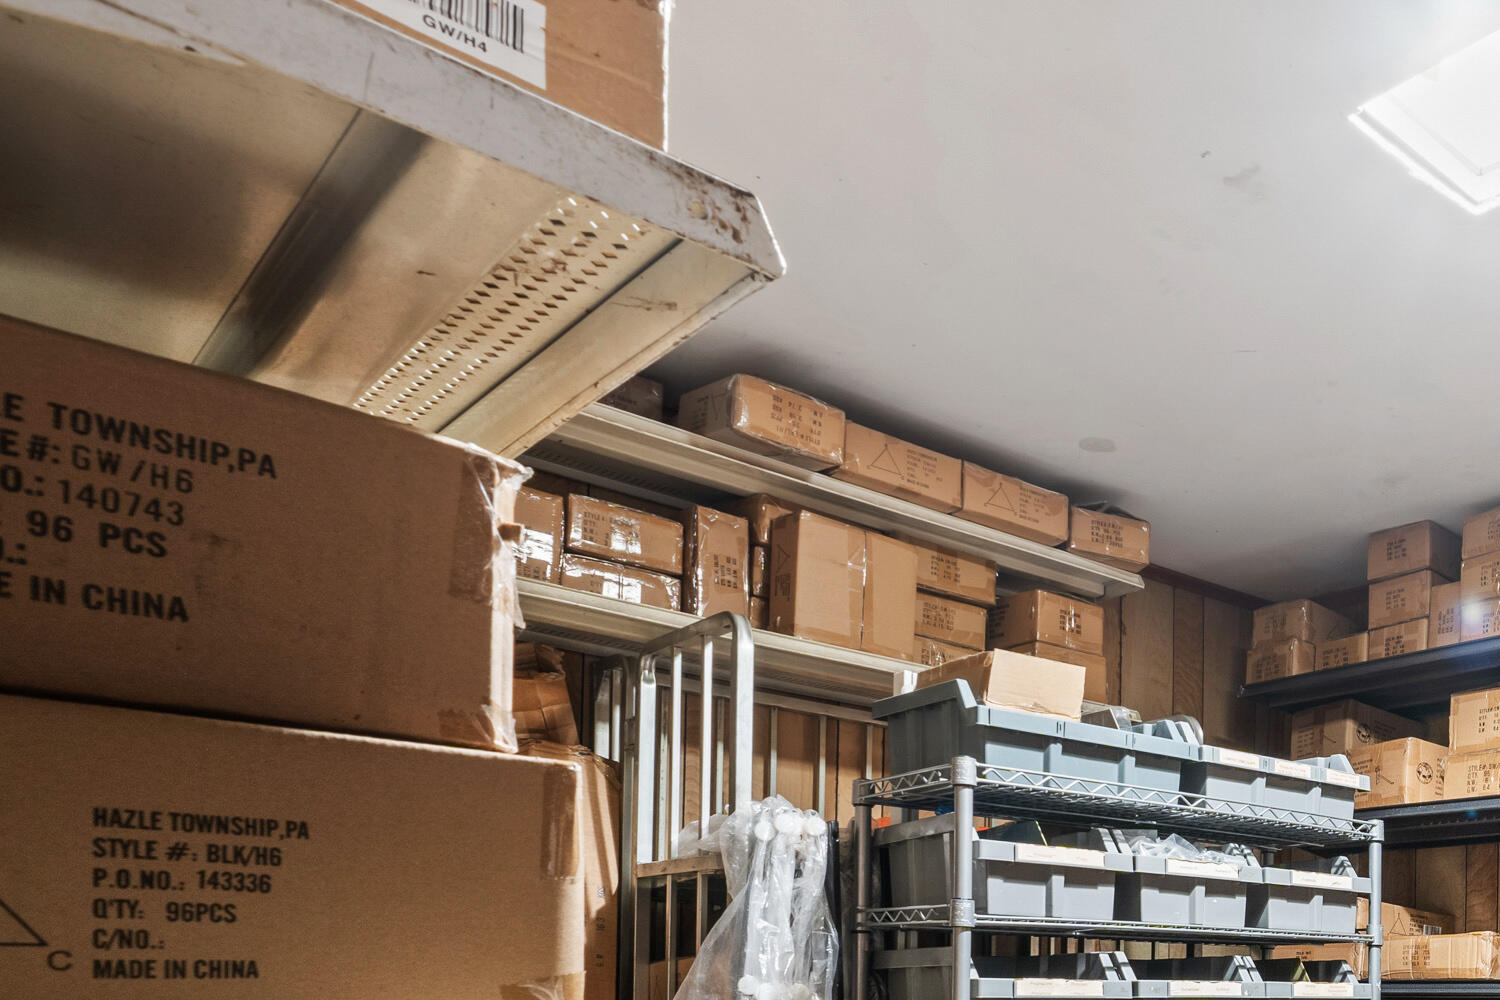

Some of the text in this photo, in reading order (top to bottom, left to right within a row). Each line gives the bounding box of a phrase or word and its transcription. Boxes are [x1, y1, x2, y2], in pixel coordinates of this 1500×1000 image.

[422, 14, 488, 53] GW/H4
[46, 401, 278, 480] TOWNSHIP,PA
[58, 478, 186, 527] 140743
[26, 509, 169, 558] 96 PCS
[29, 574, 68, 606] IN
[81, 583, 191, 623] CHINA
[92, 806, 311, 842] HAZLE TOWNSHIP,PA
[91, 836, 158, 861] STYLE
[206, 842, 283, 867] BLK/H6
[196, 869, 273, 894] 143336
[165, 901, 238, 924] 96PCS
[47, 950, 73, 972] C
[92, 958, 260, 980] MADE IN CHINA
